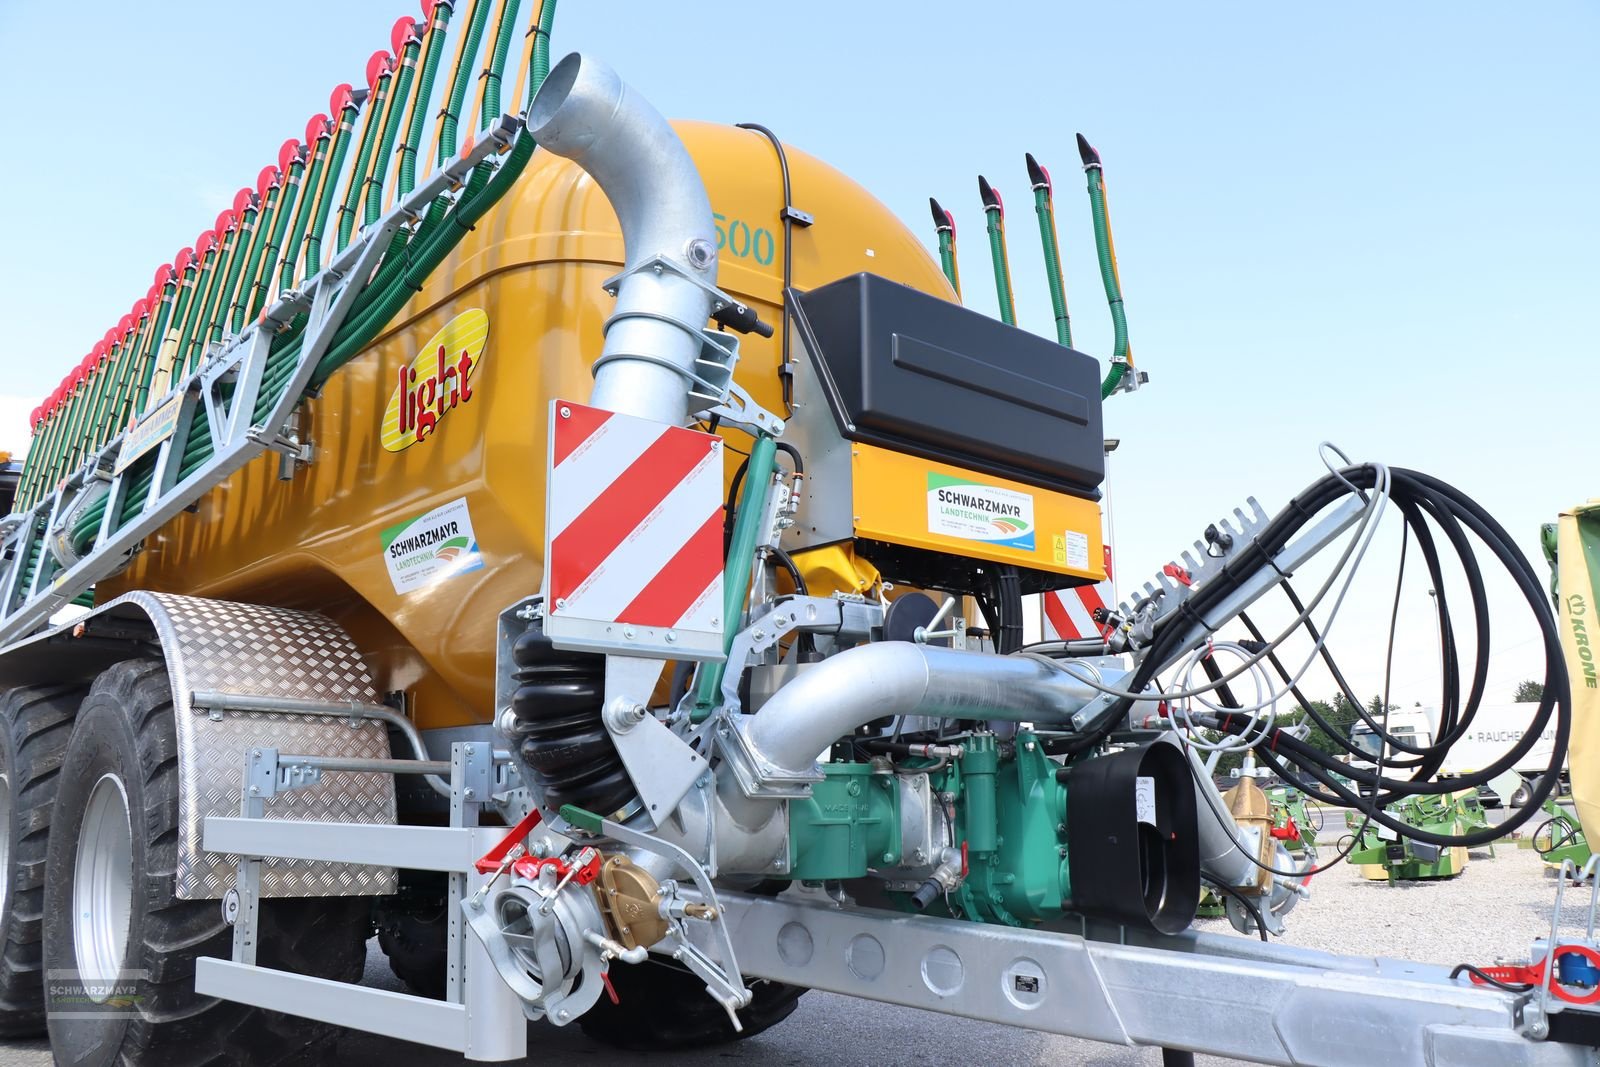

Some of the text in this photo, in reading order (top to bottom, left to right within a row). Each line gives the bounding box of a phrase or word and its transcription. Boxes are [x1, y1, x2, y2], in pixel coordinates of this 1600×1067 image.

[399, 344, 473, 442] light
[938, 489, 1021, 518] SCHWARZMAYR
[940, 506, 990, 523] LANDTECHNIK
[390, 521, 459, 558] SCHWARZMAYR
[395, 550, 435, 571] LANDTECHNIK
[1571, 618, 1597, 689] KRONE
